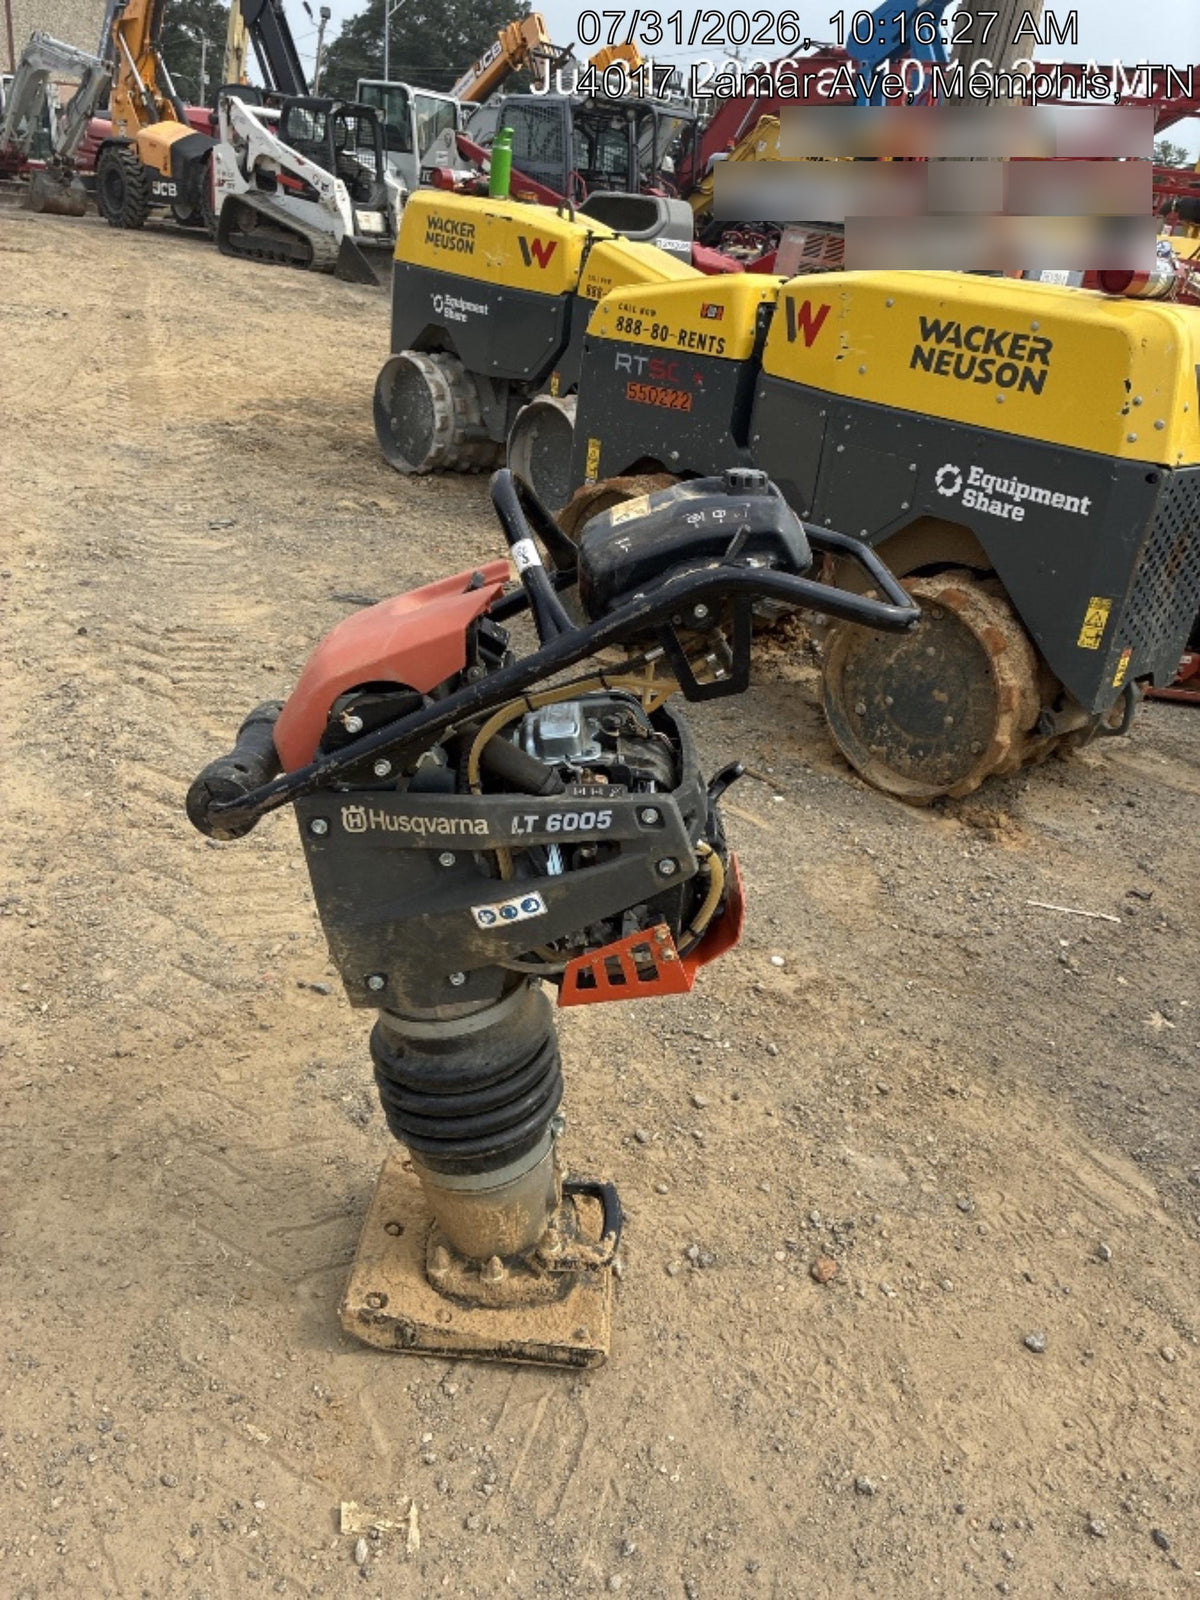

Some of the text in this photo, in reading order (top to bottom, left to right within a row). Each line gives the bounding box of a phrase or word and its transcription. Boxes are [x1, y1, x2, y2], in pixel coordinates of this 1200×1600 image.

[475, 40, 502, 76] JCB
[152, 181, 178, 197] JCB
[425, 231, 474, 255] NEUSON
[426, 214, 476, 239] WACKER
[615, 315, 726, 355] 888-80-RENTS
[918, 315, 1053, 367] WACKER
[909, 344, 1047, 395] NEUSON
[628, 383, 690, 410] 550222
[961, 487, 1026, 522] Share
[966, 464, 1092, 516] Equipment
[368, 808, 490, 836] Husqvarna
[511, 815, 539, 835] LT
[545, 810, 613, 833] 6005
